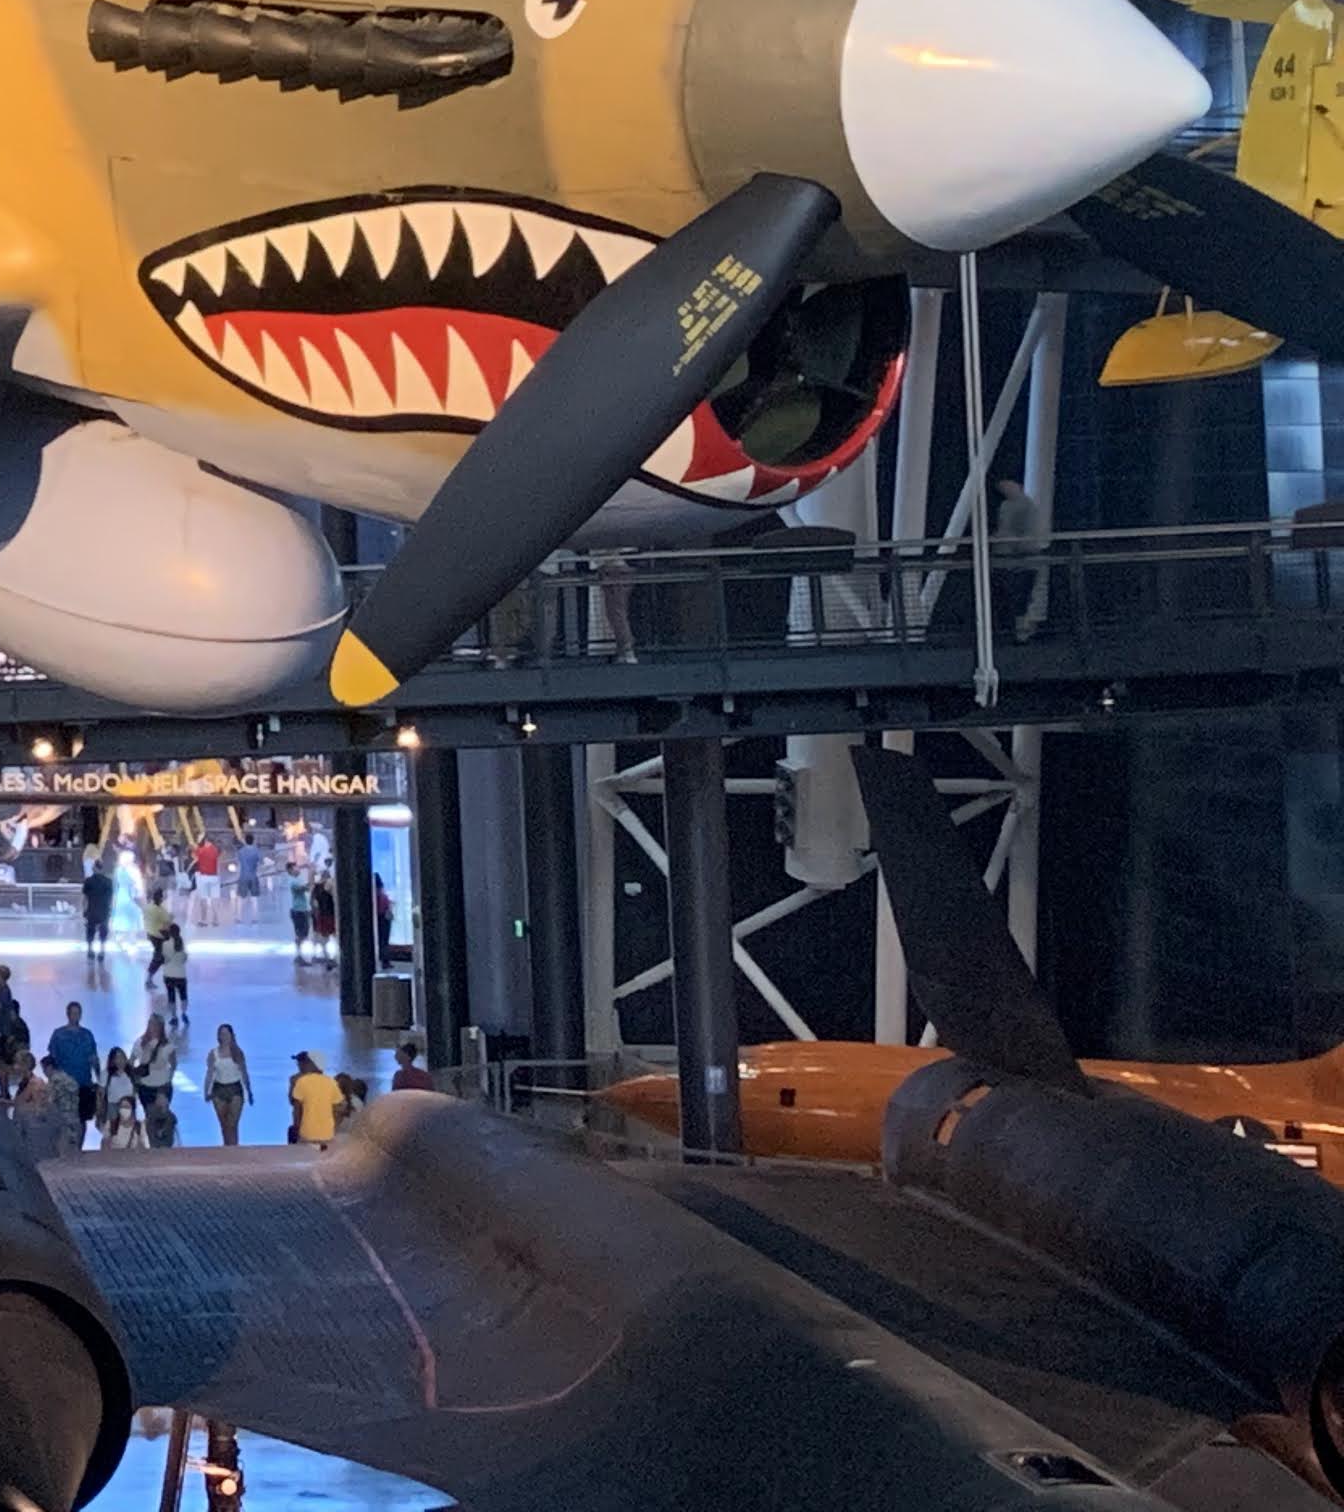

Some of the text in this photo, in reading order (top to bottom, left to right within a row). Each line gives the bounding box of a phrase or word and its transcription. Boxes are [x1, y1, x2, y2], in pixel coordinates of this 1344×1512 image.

[1273, 53, 1296, 79] 44
[32, 772, 49, 793] S.
[204, 773, 271, 795] SPACE
[277, 773, 381, 795] HANGAR
